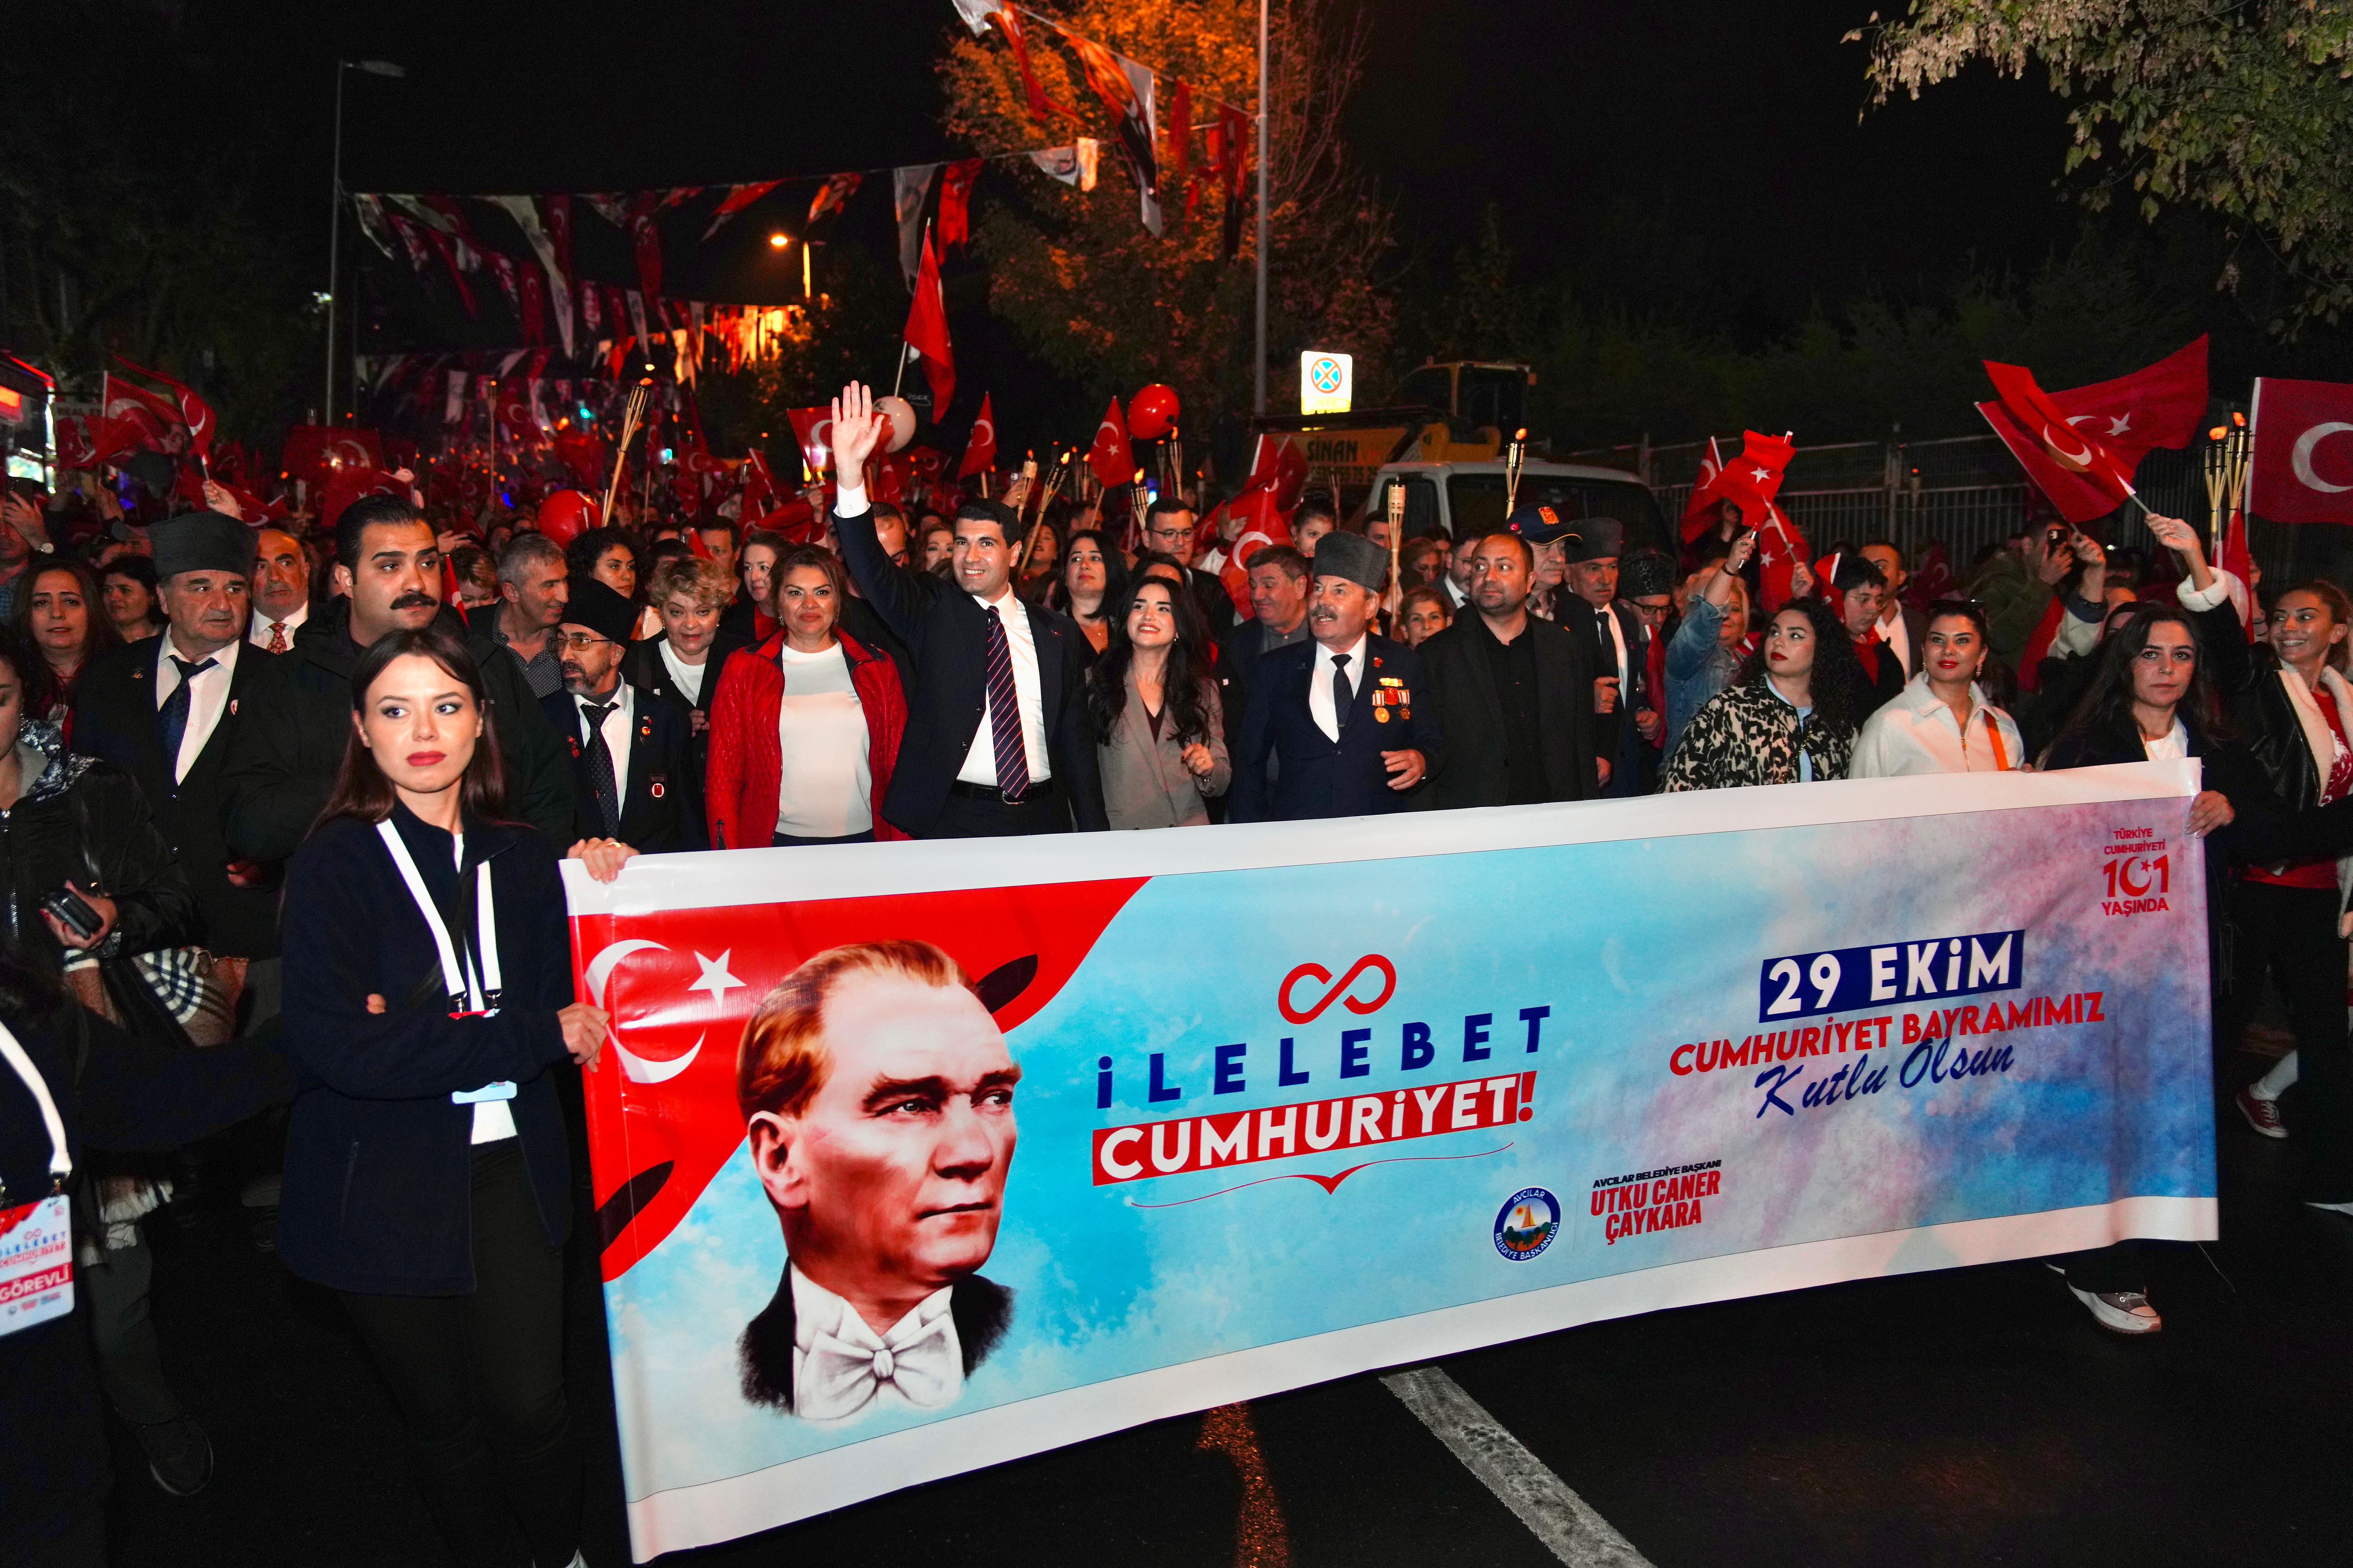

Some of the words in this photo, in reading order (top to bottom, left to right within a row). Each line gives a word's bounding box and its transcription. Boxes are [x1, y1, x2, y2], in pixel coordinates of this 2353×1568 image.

[2103, 838, 2166, 855] CUMHURİYETİ
[2114, 827, 2153, 840] TÜRKİYE
[2101, 897, 2170, 917] YAŞINDA
[1767, 953, 1841, 1015] 29
[1669, 1016, 1893, 1076] CUMHURİYET
[1901, 991, 2106, 1045] BAYRAMIMIZ
[1754, 1053, 1889, 1119] Kutlu
[1899, 1037, 2016, 1089] Olsun
[1593, 1174, 1635, 1188] AVCILAR
[1635, 1166, 1680, 1181] BELEDİYE
[1681, 1159, 1722, 1173] BAŞKANI
[1513, 1189, 1546, 1204] AVCILAR
[1591, 1182, 1648, 1216] UTKU
[1652, 1170, 1721, 1205] CANER
[1605, 1199, 1702, 1245] ÇAYKARA
